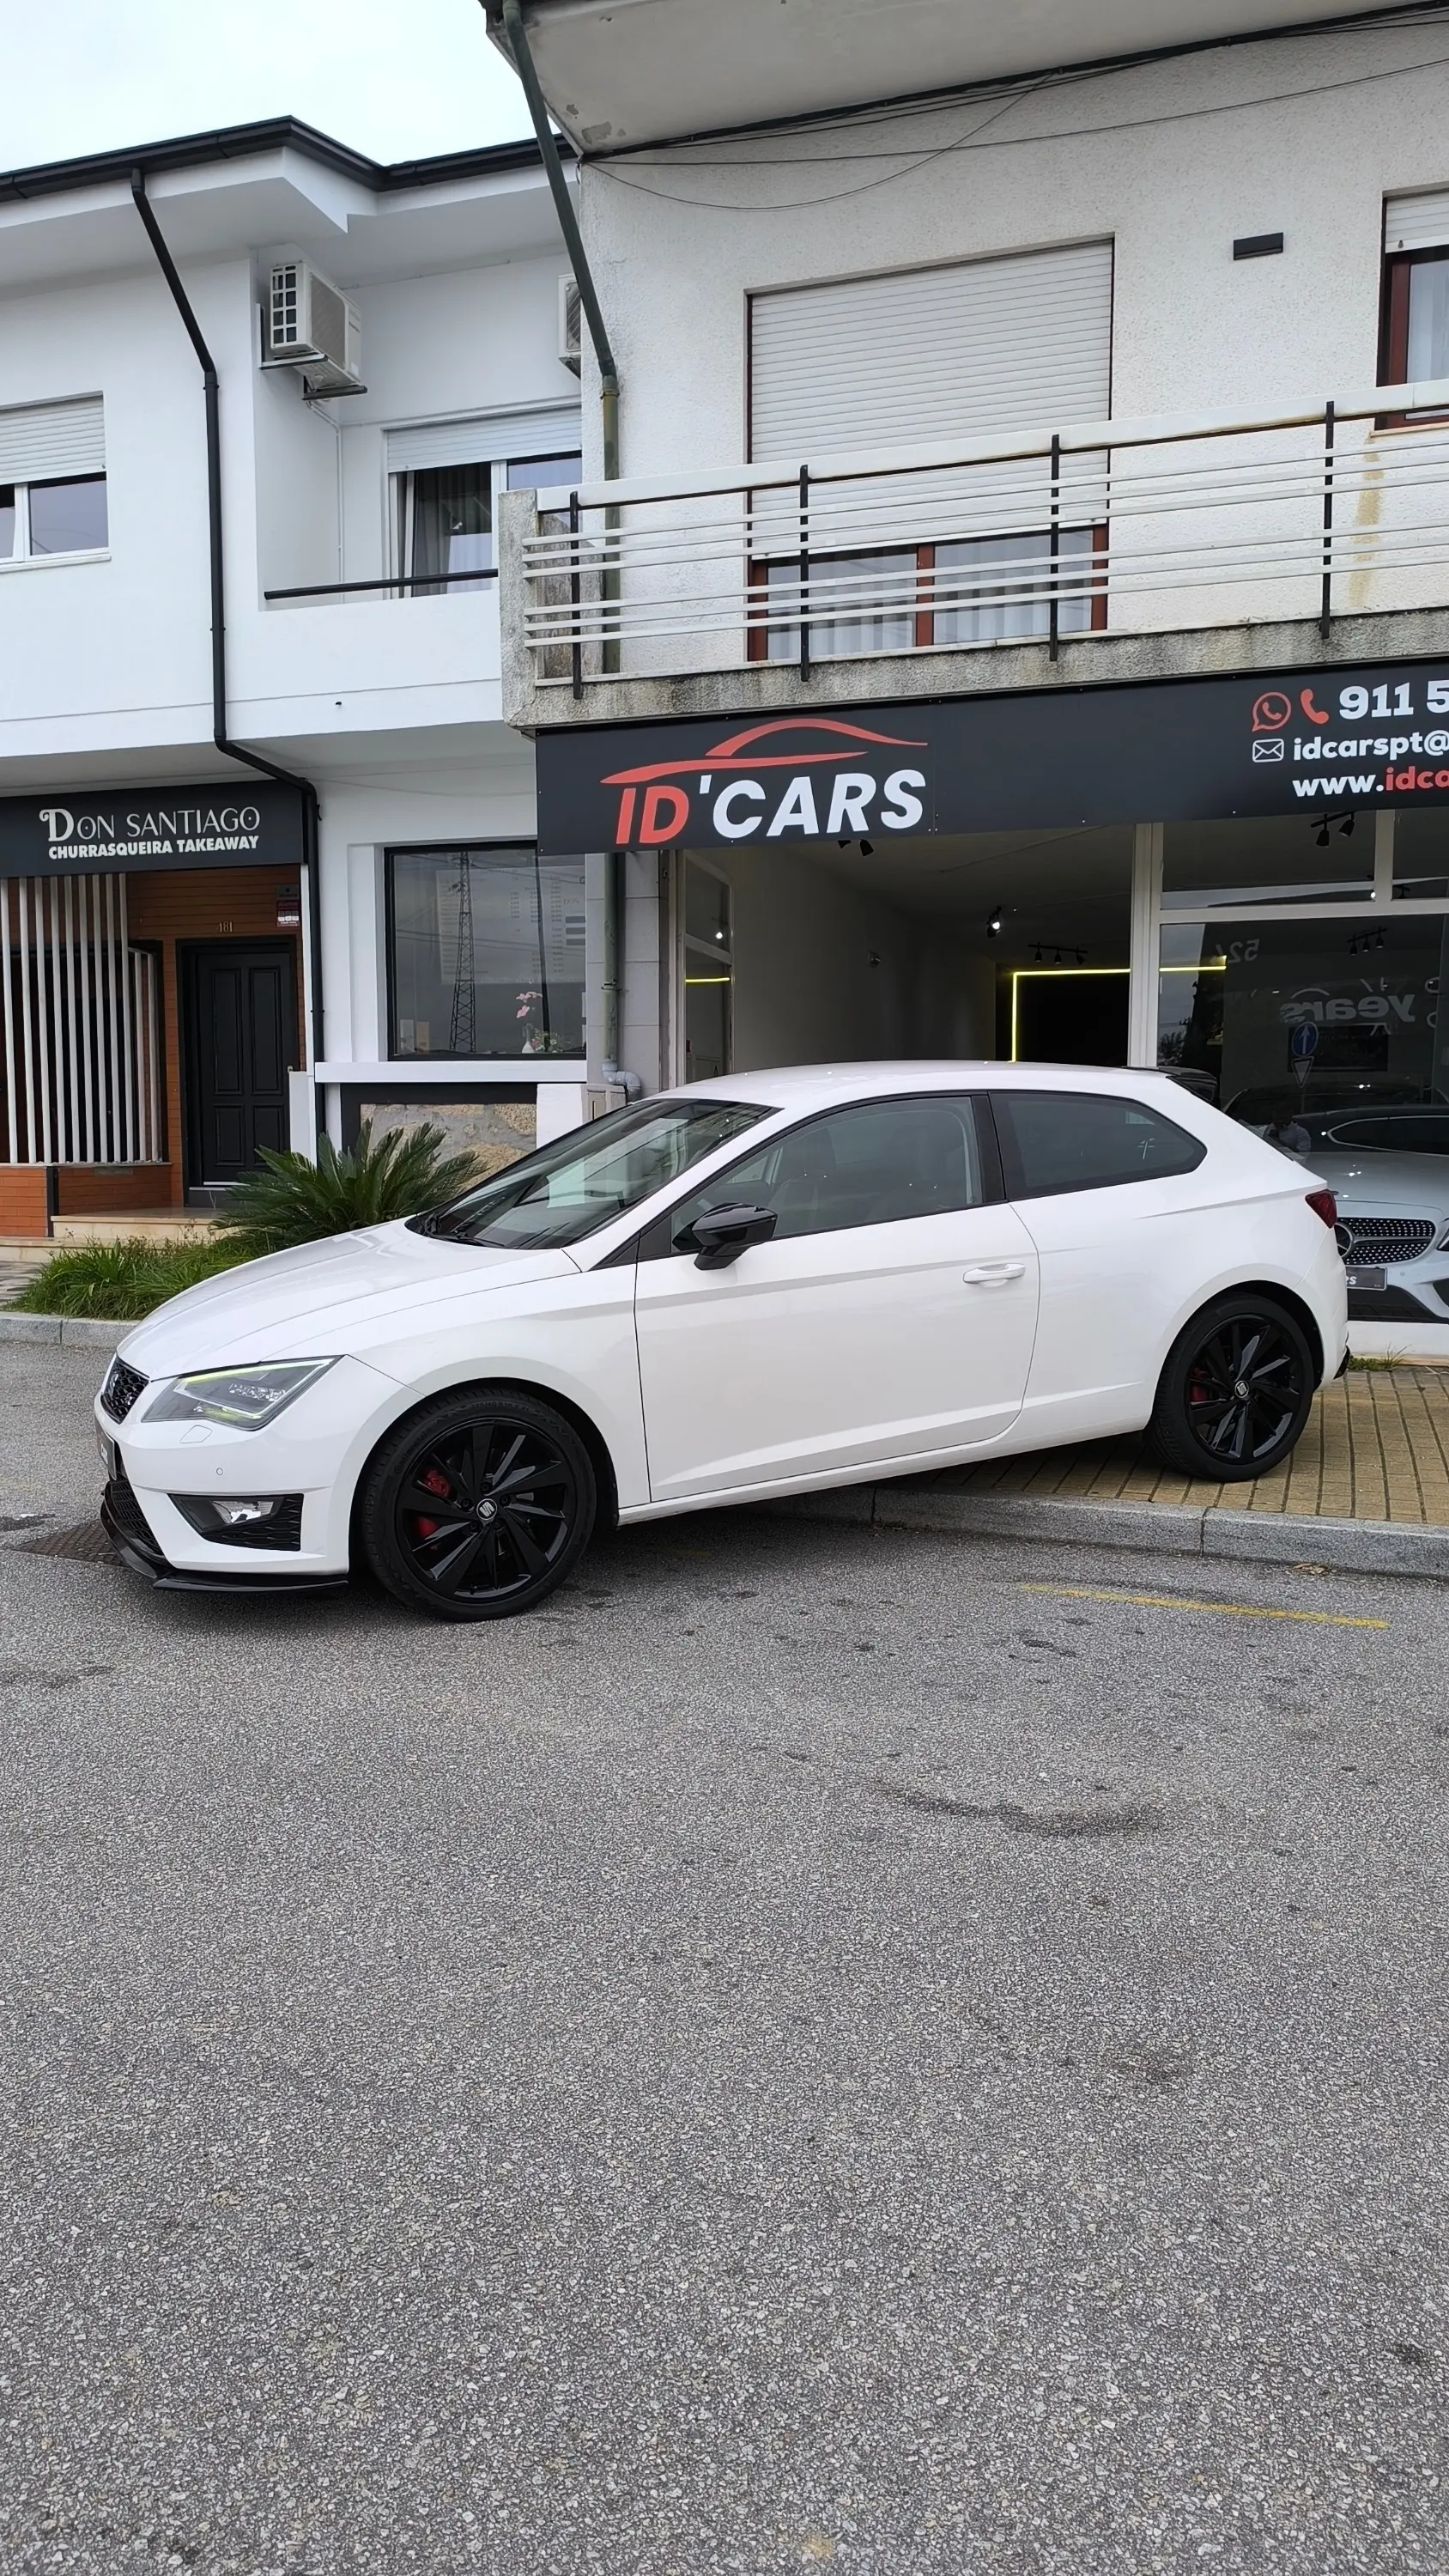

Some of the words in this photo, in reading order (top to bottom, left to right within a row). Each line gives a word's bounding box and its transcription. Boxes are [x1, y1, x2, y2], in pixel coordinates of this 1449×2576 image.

[1339, 682, 1414, 720] 911
[1294, 730, 1449, 761] idcarspt@
[126, 806, 260, 837] SANTIAGO
[615, 769, 926, 845] ID'CARS
[49, 841, 173, 860] CHURRASQUEIRA
[177, 835, 259, 853] TAKEAWAY
